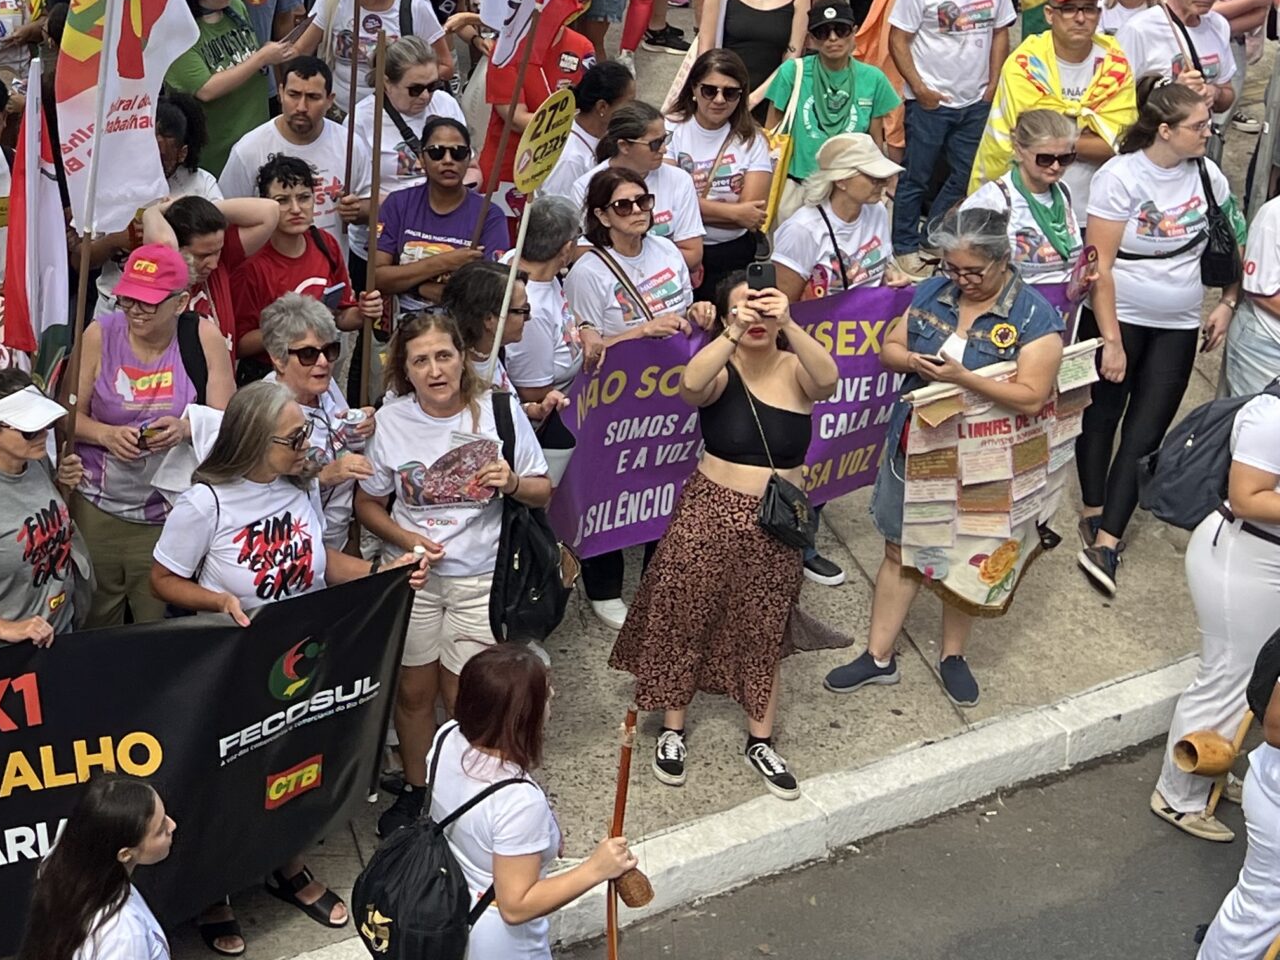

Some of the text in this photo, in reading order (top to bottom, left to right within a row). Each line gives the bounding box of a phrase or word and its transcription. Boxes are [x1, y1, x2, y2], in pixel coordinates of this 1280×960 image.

[133, 258, 159, 274] CTB
[135, 370, 173, 391] CTB
[576, 362, 628, 431] NÃO
[876, 371, 888, 398] O
[604, 412, 680, 446] SOMOS
[820, 407, 872, 440] CALA
[957, 416, 1012, 440] LINHAS
[616, 441, 693, 475] E A VOZ
[836, 443, 878, 480] VOZ
[22, 498, 63, 536] FIM
[583, 483, 676, 539] SILÊNCIO
[245, 511, 293, 550] FIM
[251, 539, 313, 572] ESCALA
[256, 564, 309, 601] 6X1
[219, 676, 382, 759] FECOSUL
[268, 763, 319, 801] CTB
